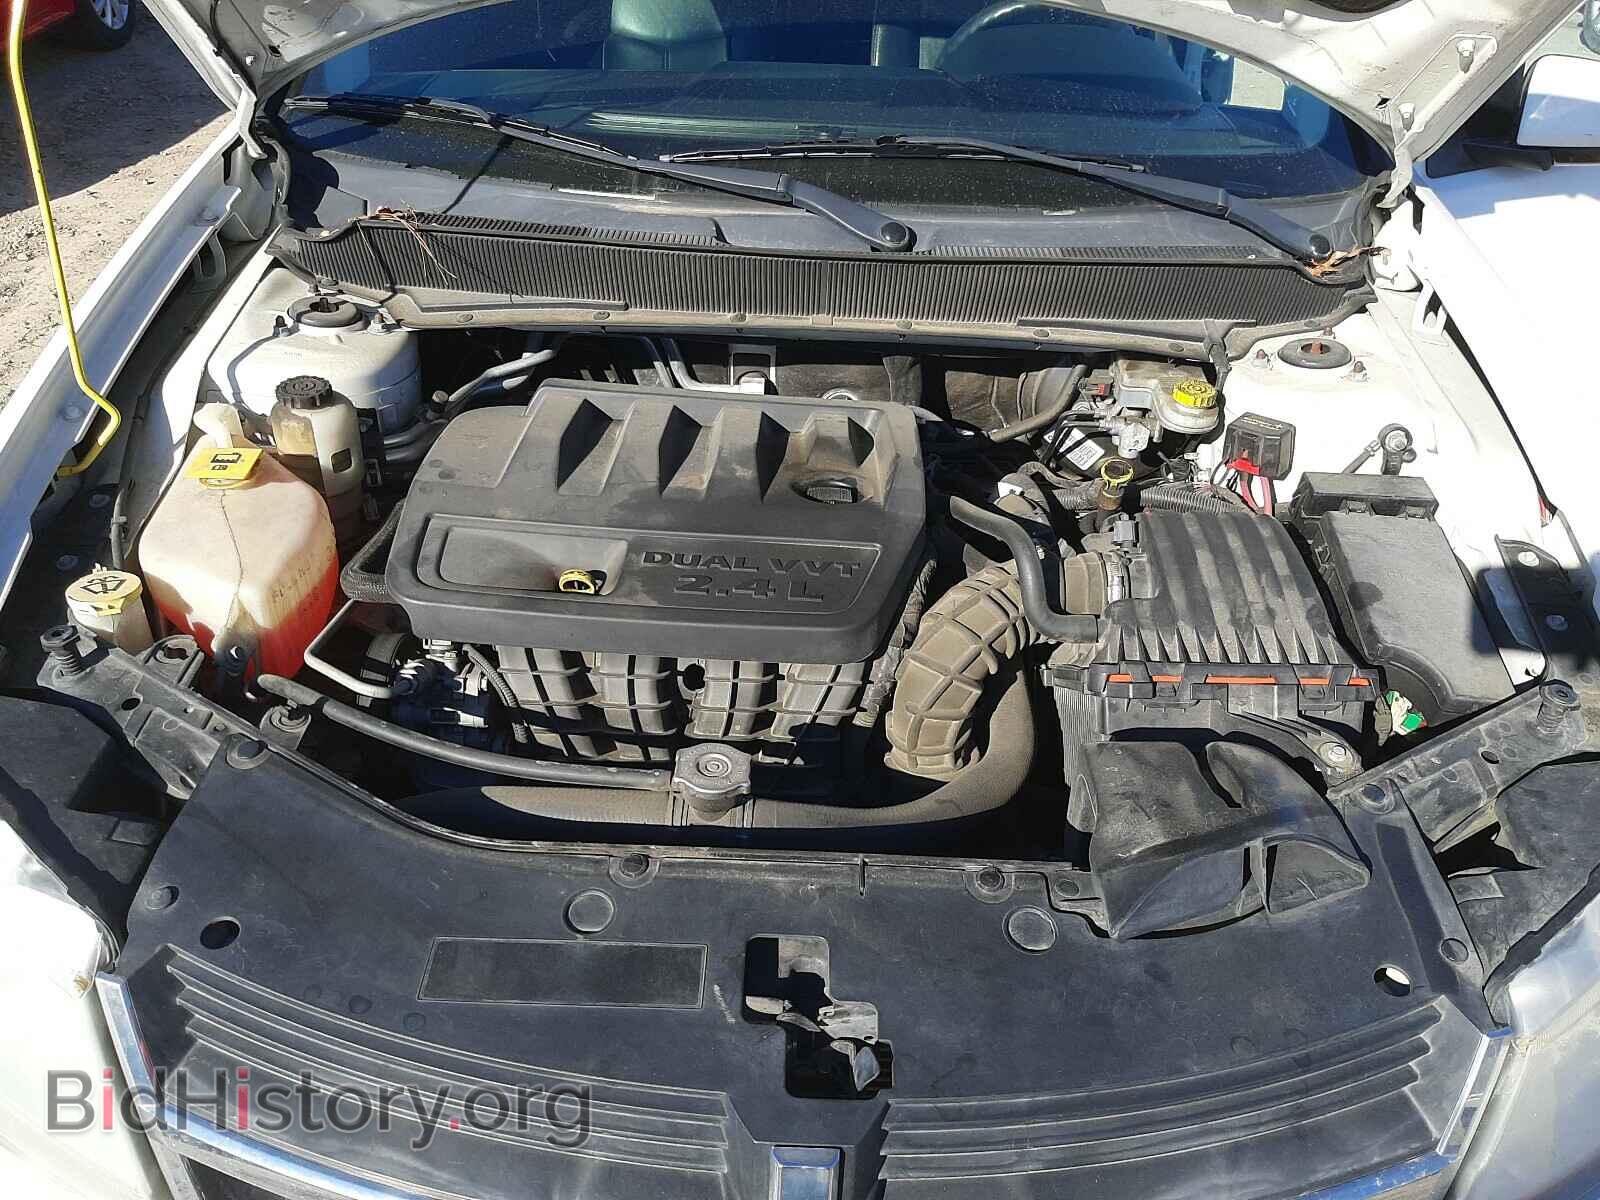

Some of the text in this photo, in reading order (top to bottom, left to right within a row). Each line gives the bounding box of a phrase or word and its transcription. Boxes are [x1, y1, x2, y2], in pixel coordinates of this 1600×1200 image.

[642, 550, 862, 577] DUAL VVT
[673, 574, 824, 602] 2.4L
